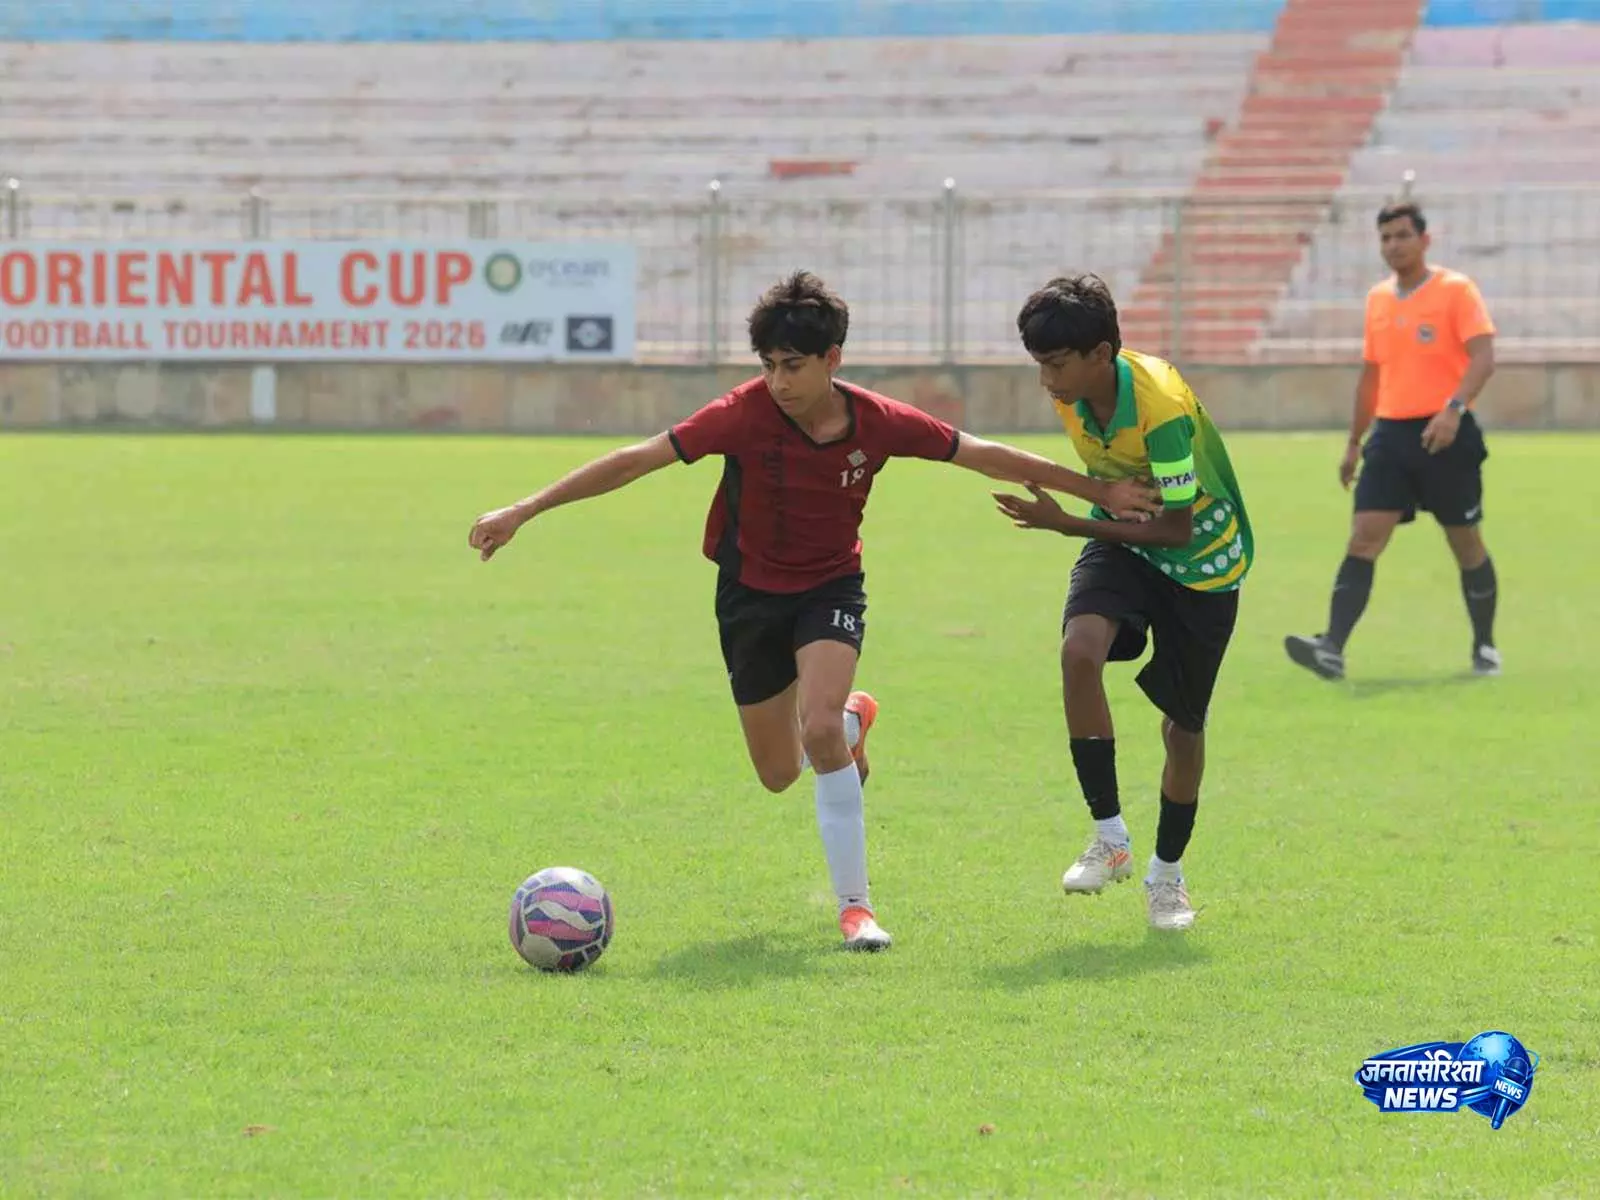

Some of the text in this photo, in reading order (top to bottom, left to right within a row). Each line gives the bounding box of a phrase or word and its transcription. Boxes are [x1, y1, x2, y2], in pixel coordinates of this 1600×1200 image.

[0, 250, 474, 307] ORIENTAL CUP
[0, 319, 149, 350] OOTBALL
[163, 319, 389, 350] TOURNAMENT
[404, 320, 486, 350] 2026
[831, 608, 856, 632] 18
